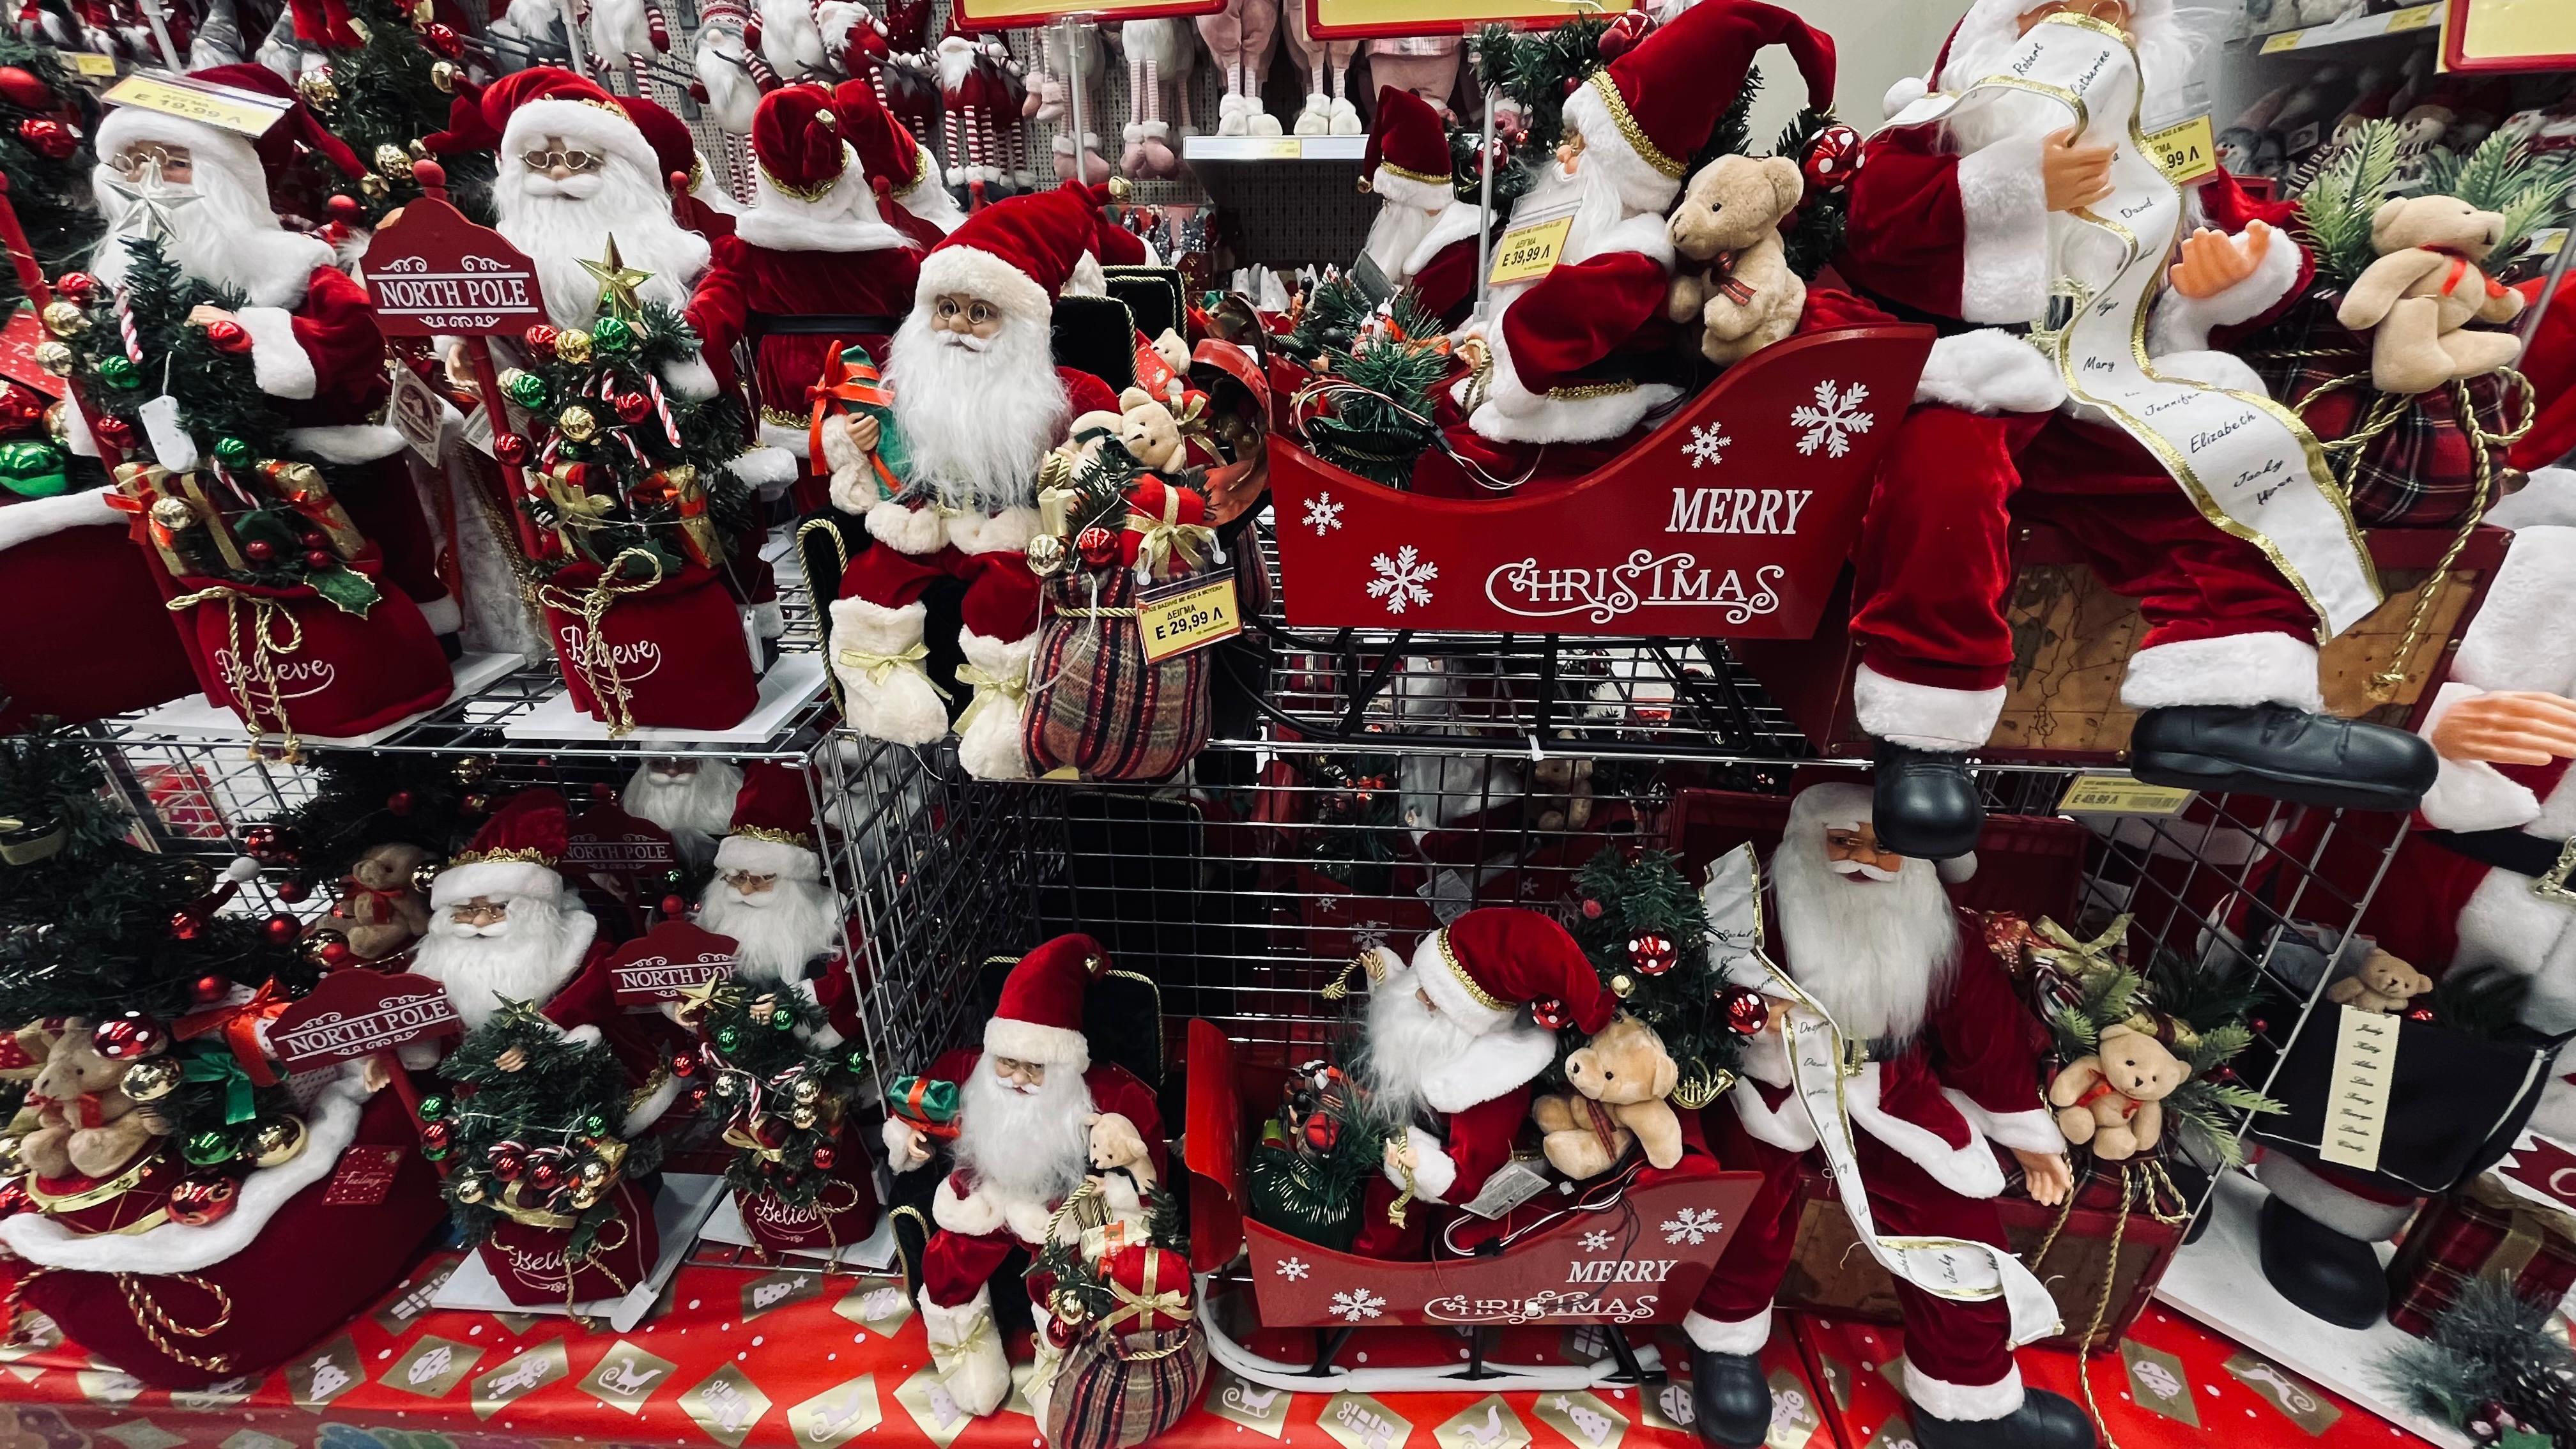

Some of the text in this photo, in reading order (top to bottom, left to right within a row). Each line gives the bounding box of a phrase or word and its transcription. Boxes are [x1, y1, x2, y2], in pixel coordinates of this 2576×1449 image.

[2070, 50, 2110, 97] Catherine
[158, 98, 221, 118] 19,99
[1511, 246, 1540, 266] 39,99
[378, 279, 529, 307] NORTH POLE
[2083, 356, 2115, 372] Mary
[2145, 392, 2202, 416] Jennifer
[2190, 411, 2257, 454] Elizabeth
[1665, 487, 1813, 535] MERRY
[1485, 549, 1784, 624] CHRISTMAS
[1167, 604, 1197, 621] ΔΕΙΓΜΑ
[1169, 611, 1208, 635] 29,99
[624, 845, 668, 859] POLE
[620, 968, 694, 988] NORTH
[287, 1000, 450, 1055] NORTH POLE
[1565, 1259, 1679, 1283] MERRY
